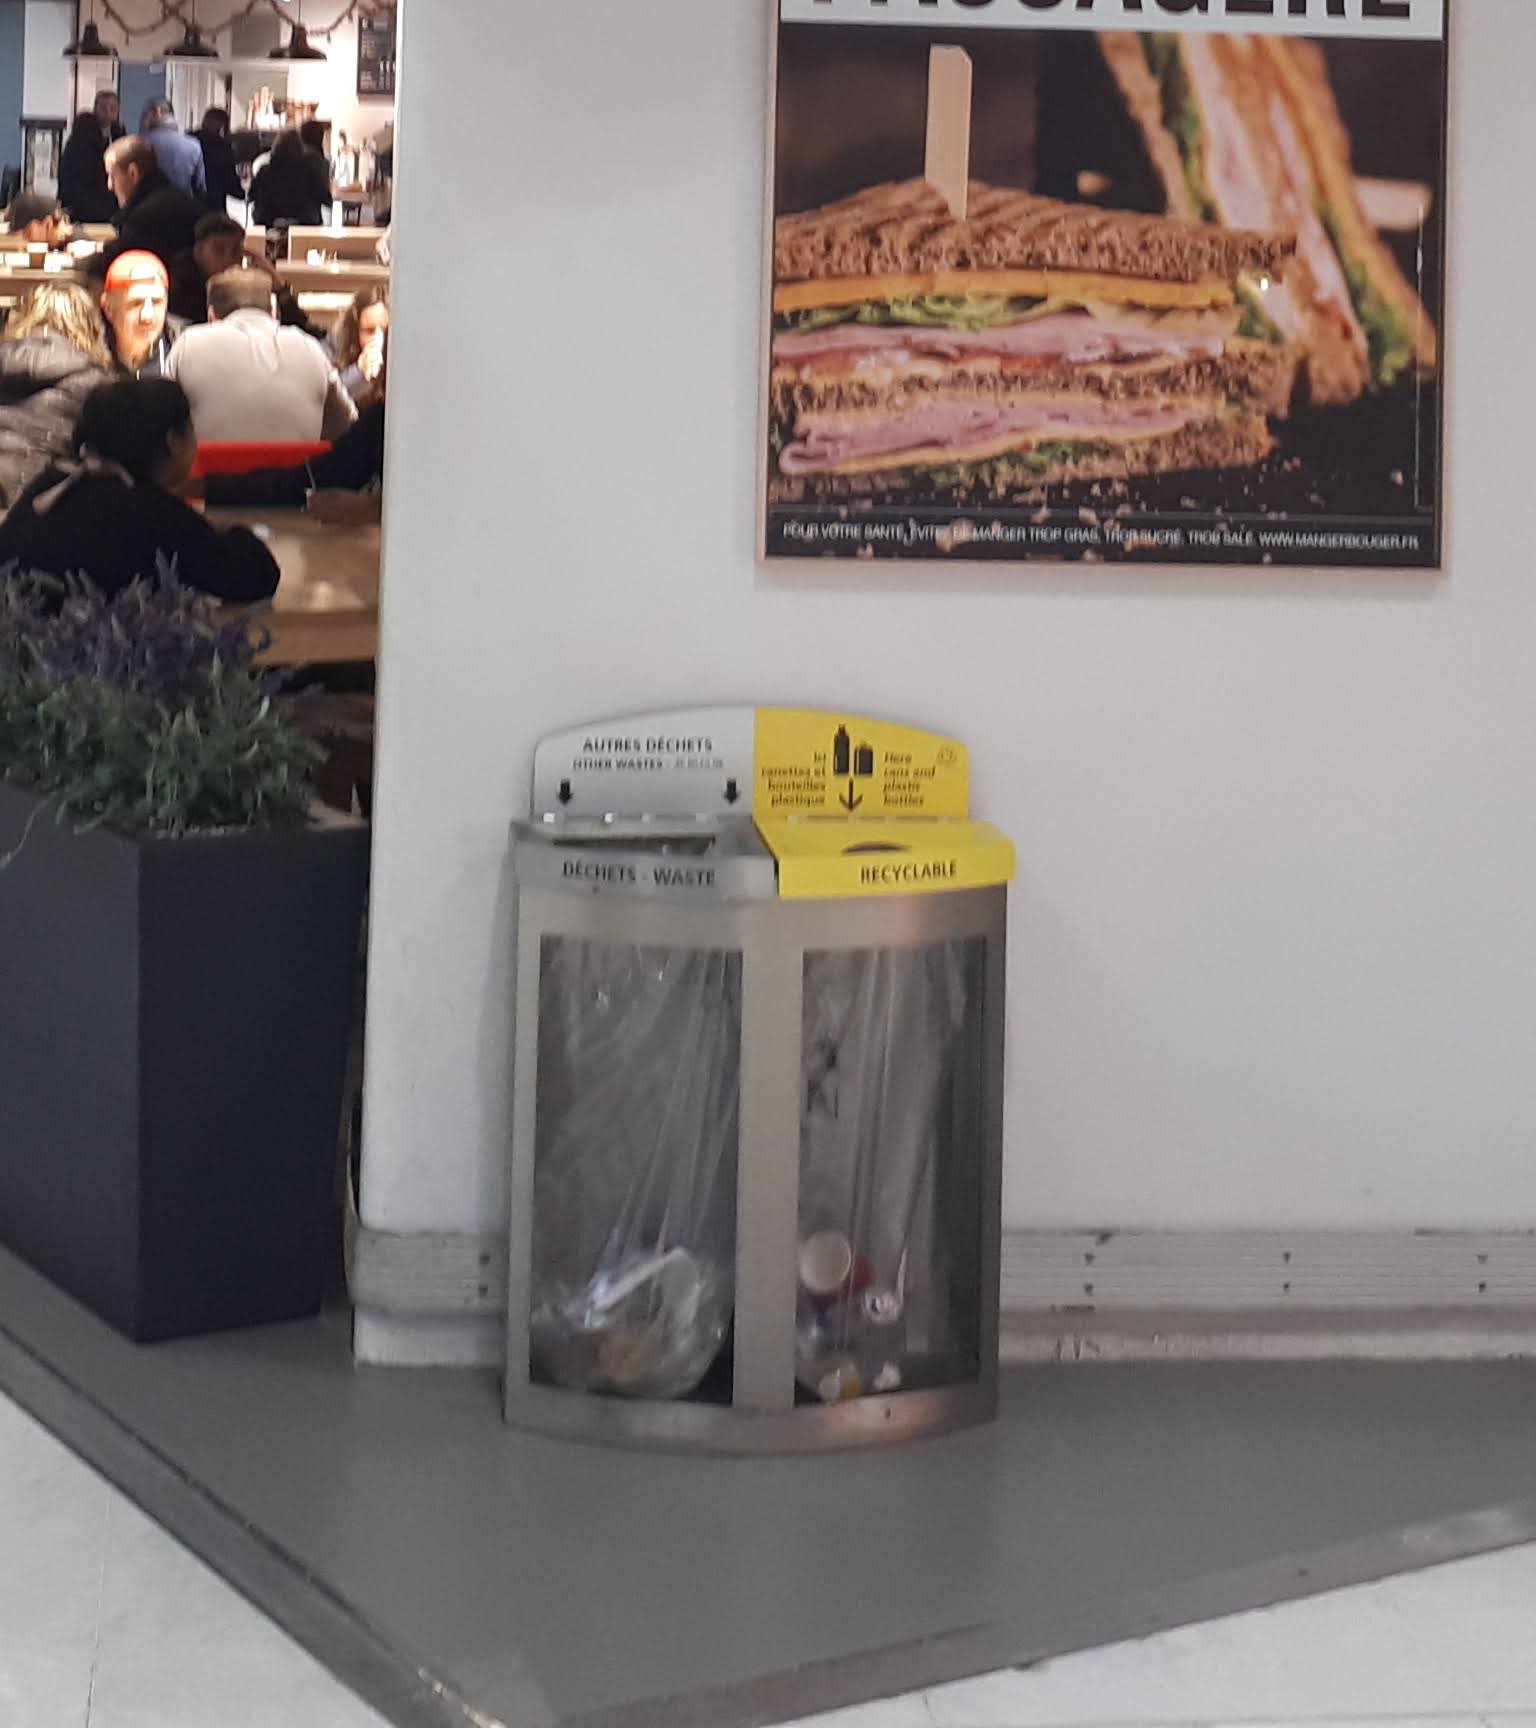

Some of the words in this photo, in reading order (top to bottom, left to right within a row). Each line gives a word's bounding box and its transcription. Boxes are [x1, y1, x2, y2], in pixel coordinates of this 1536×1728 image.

[783, 522, 819, 539] POUR
[820, 523, 862, 540] VOTRE
[972, 525, 1026, 543] MANGER
[1029, 526, 1062, 543] TROP
[582, 736, 641, 753] AUTRES
[645, 735, 713, 753] DÉCHETS
[563, 859, 637, 881] DÉCHETS
[653, 866, 716, 887] WASTE
[860, 858, 958, 885] RECYCLABLE
